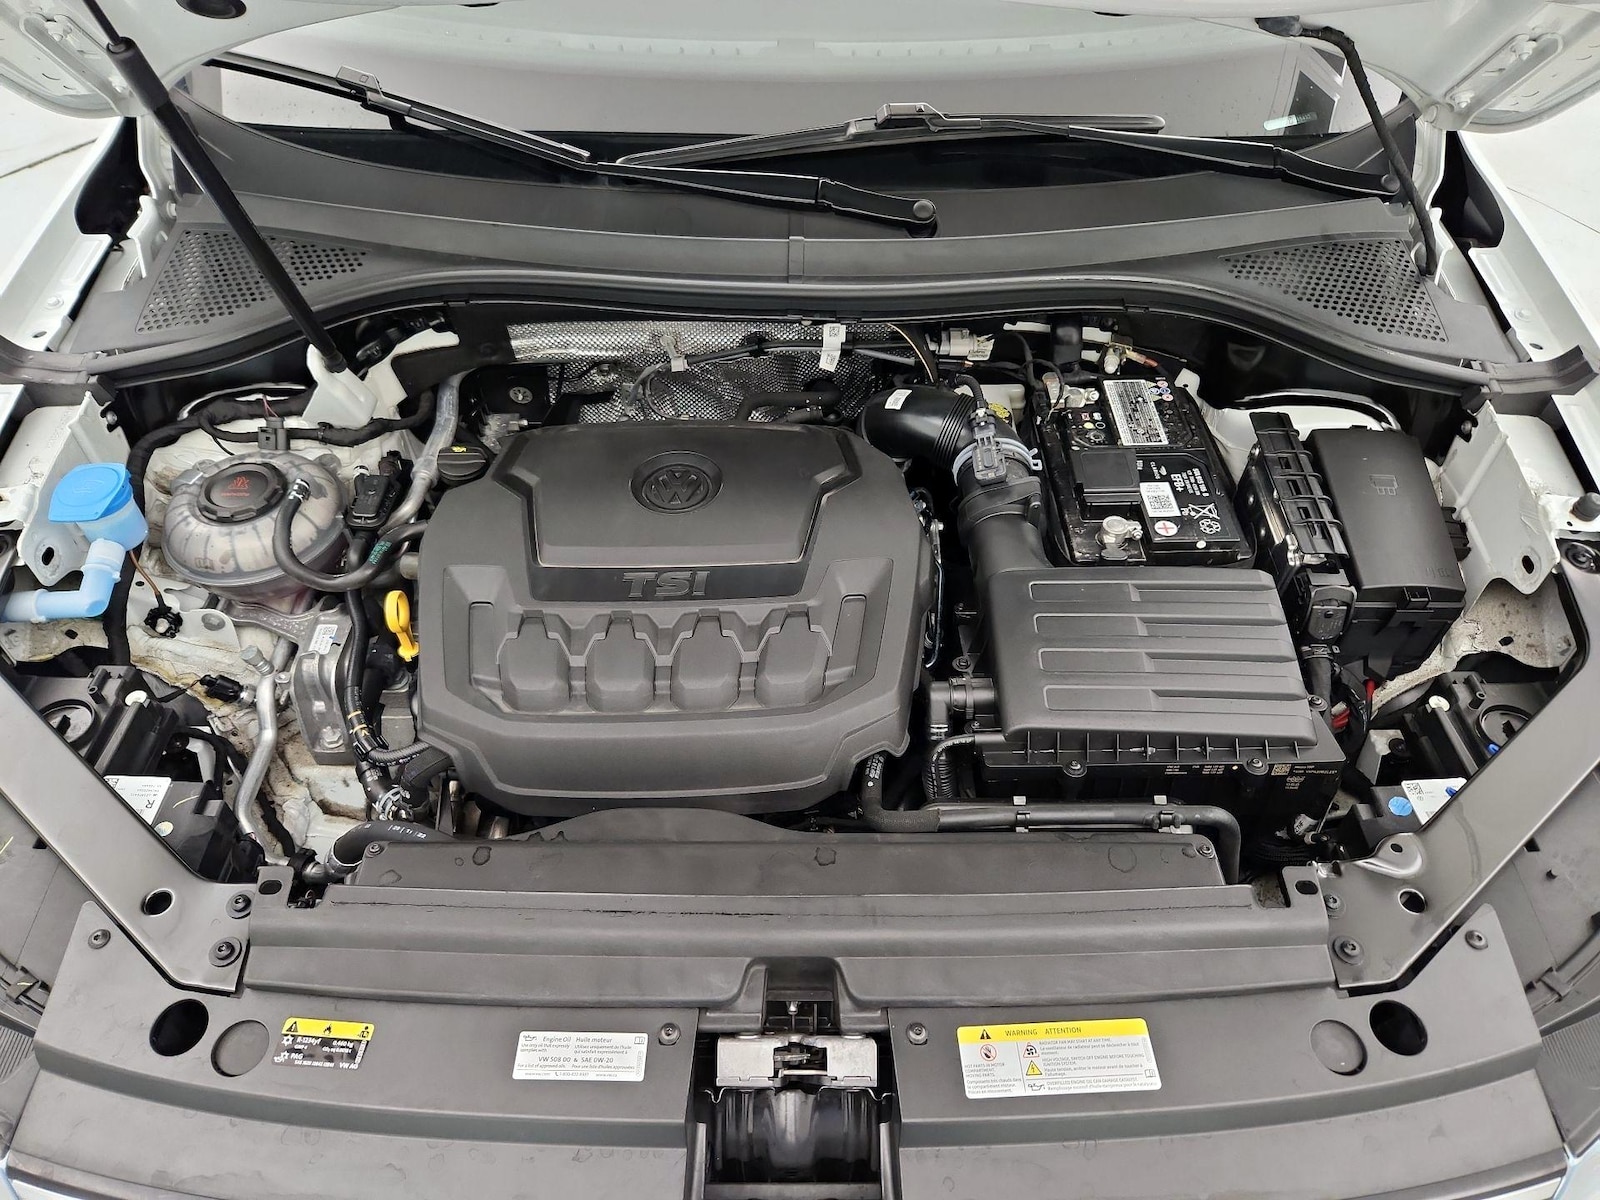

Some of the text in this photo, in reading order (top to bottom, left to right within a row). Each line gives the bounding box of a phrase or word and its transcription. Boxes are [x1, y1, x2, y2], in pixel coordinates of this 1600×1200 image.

[1170, 474, 1184, 492] EFB+
[622, 571, 710, 598] TSI
[146, 800, 155, 808] R
[296, 1037, 322, 1045] R-1234yf
